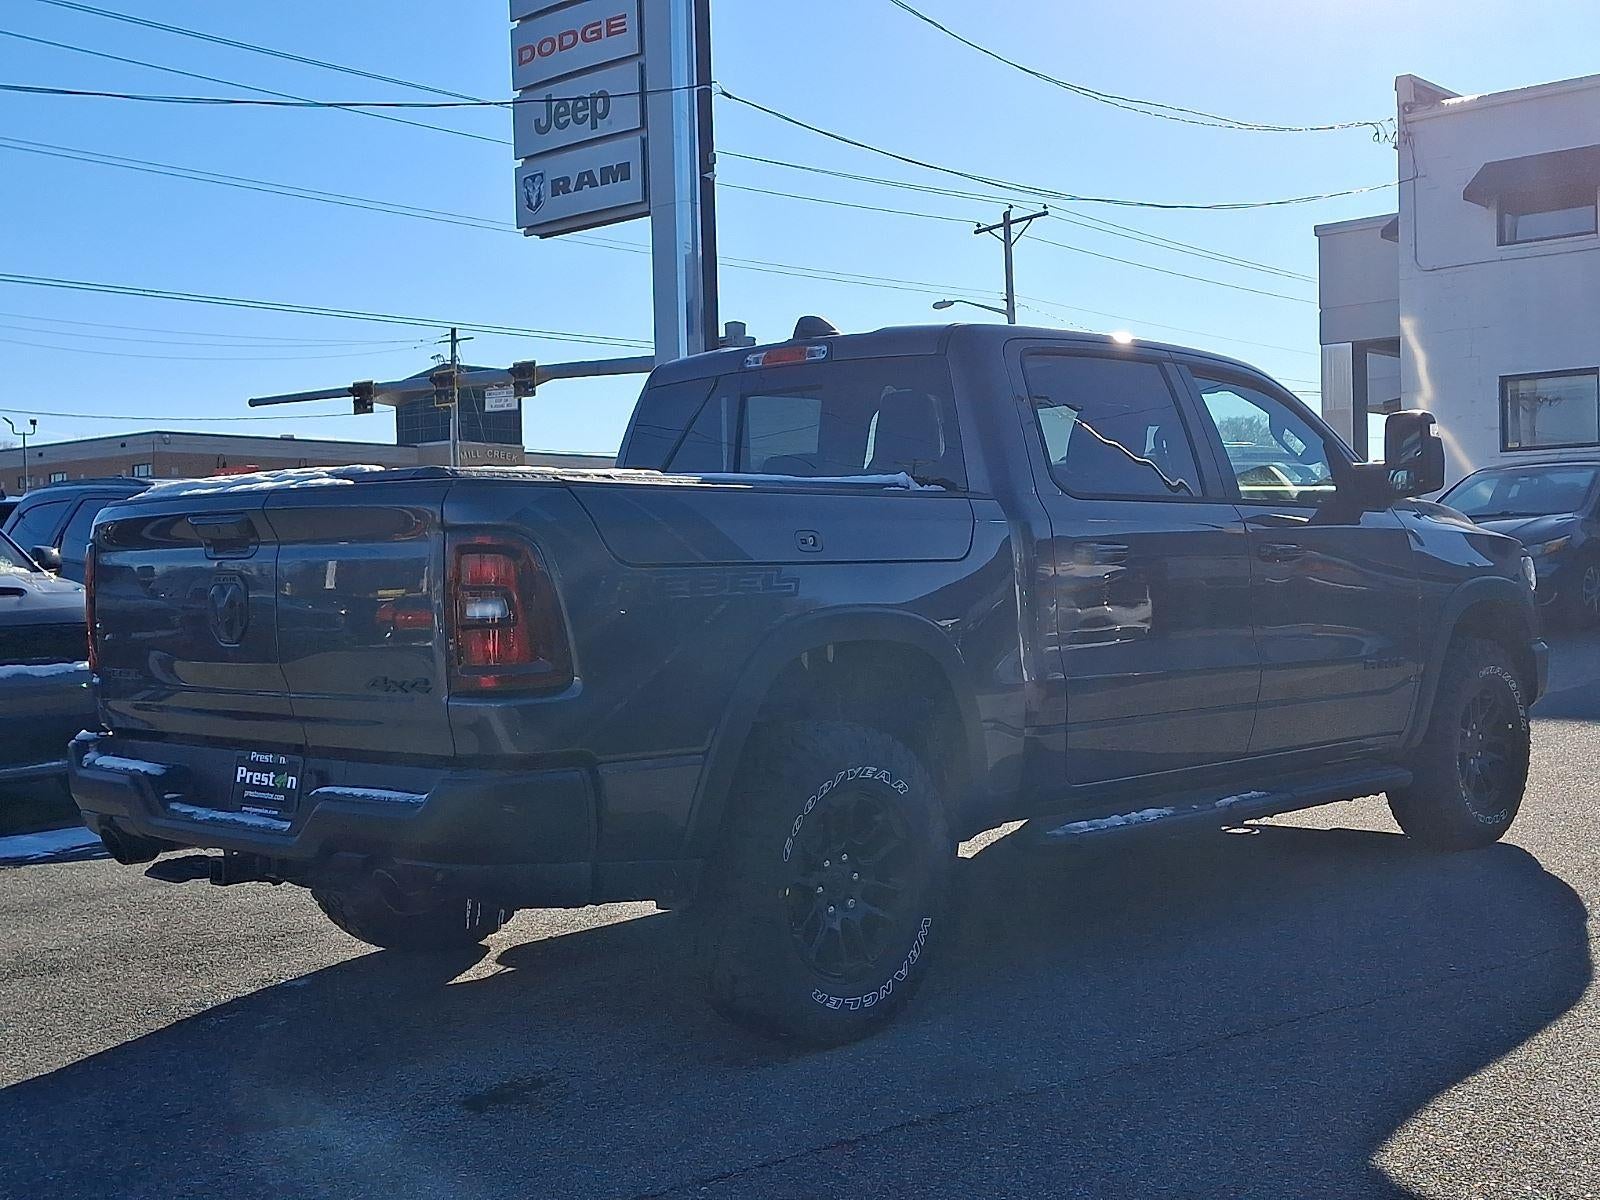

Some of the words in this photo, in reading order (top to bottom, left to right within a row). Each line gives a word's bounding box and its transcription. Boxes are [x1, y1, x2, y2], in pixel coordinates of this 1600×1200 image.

[518, 13, 627, 67] DODGE
[533, 89, 611, 135] Jeep
[551, 161, 631, 198] RAM
[460, 449, 481, 460] MILL
[486, 449, 518, 463] CREEK
[251, 751, 287, 765] Prestn
[783, 766, 909, 862] GOODYEAR
[811, 917, 932, 1010] WRANGLER
